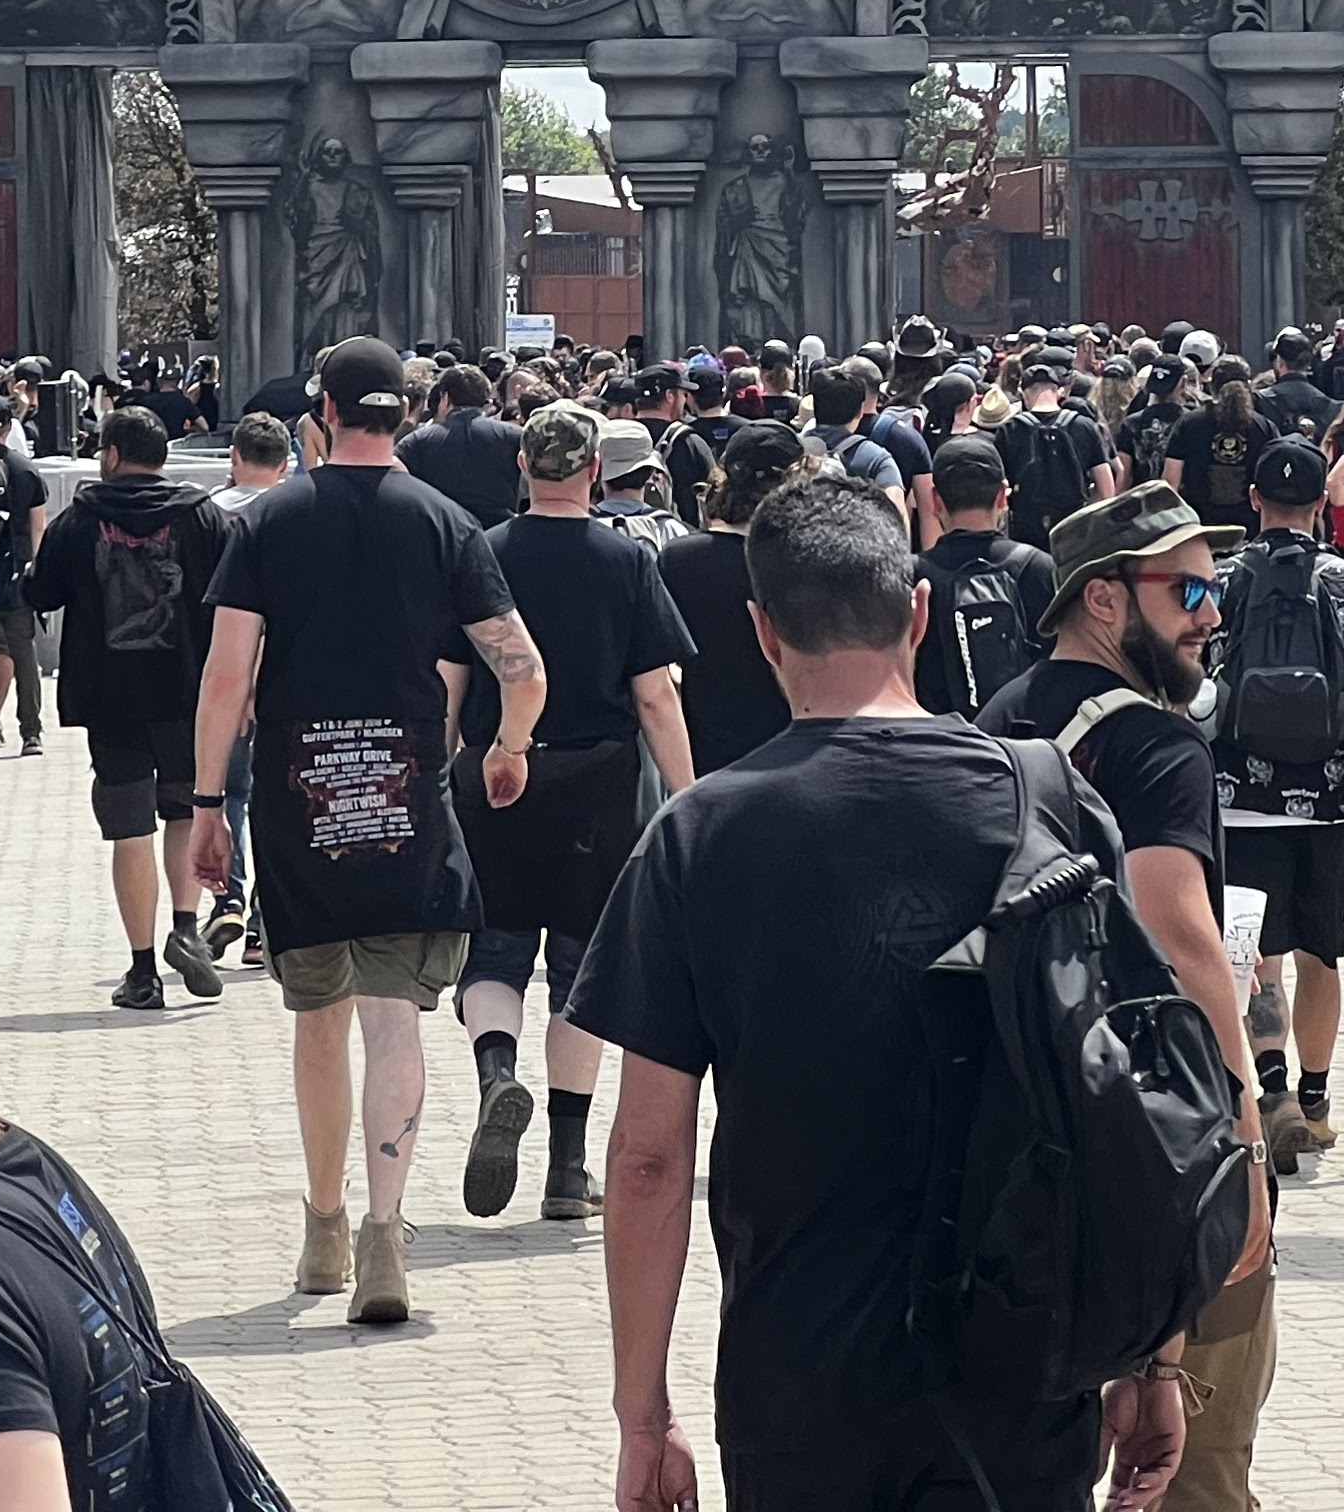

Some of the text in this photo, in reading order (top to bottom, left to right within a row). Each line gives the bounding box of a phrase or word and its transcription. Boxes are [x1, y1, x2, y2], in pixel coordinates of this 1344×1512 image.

[314, 750, 392, 767] PARKWAY DRIVE
[328, 793, 387, 813] NIGHTWISH
